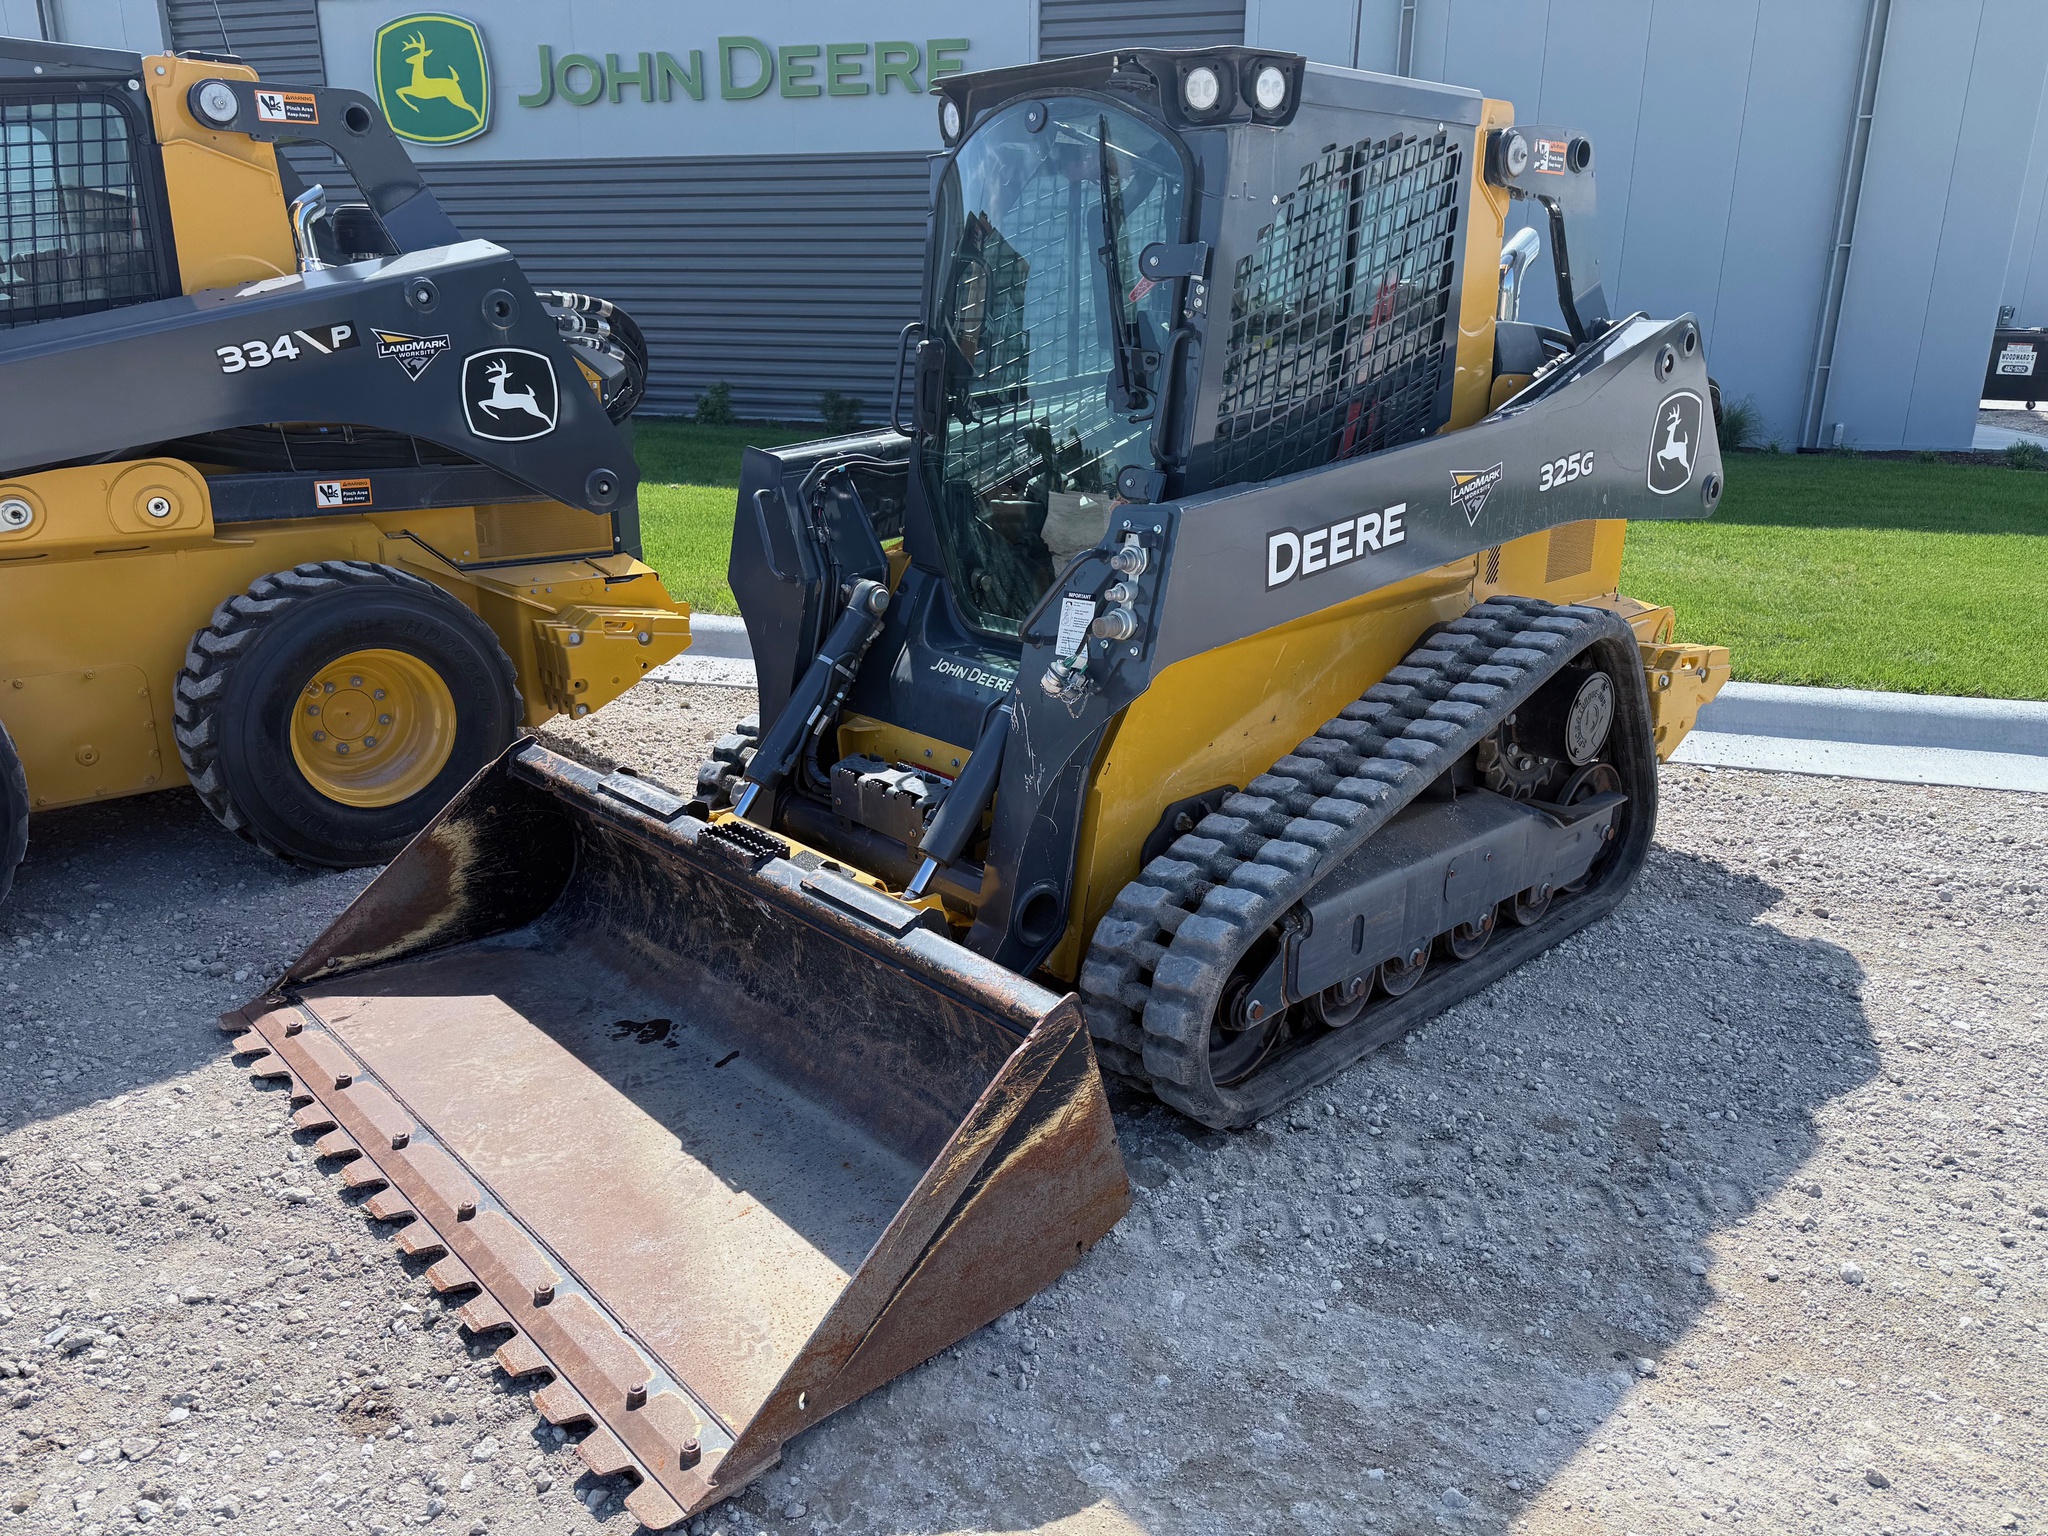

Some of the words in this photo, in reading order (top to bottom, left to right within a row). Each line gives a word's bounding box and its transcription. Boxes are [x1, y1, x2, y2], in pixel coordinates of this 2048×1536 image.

[518, 44, 704, 107] JOHN
[717, 35, 969, 100] DEERE
[216, 335, 301, 374] 334
[381, 339, 447, 354] LANDMARK
[399, 349, 435, 358] WORKSITE
[1453, 468, 1501, 500] LANDMARK
[1539, 451, 1594, 492] 325G
[1464, 483, 1491, 501] WORKSITE
[1268, 502, 1407, 587] DEERE
[1068, 592, 1092, 600] IMPORTANT
[930, 657, 969, 679] JOHN
[966, 667, 1014, 693] DEERE
